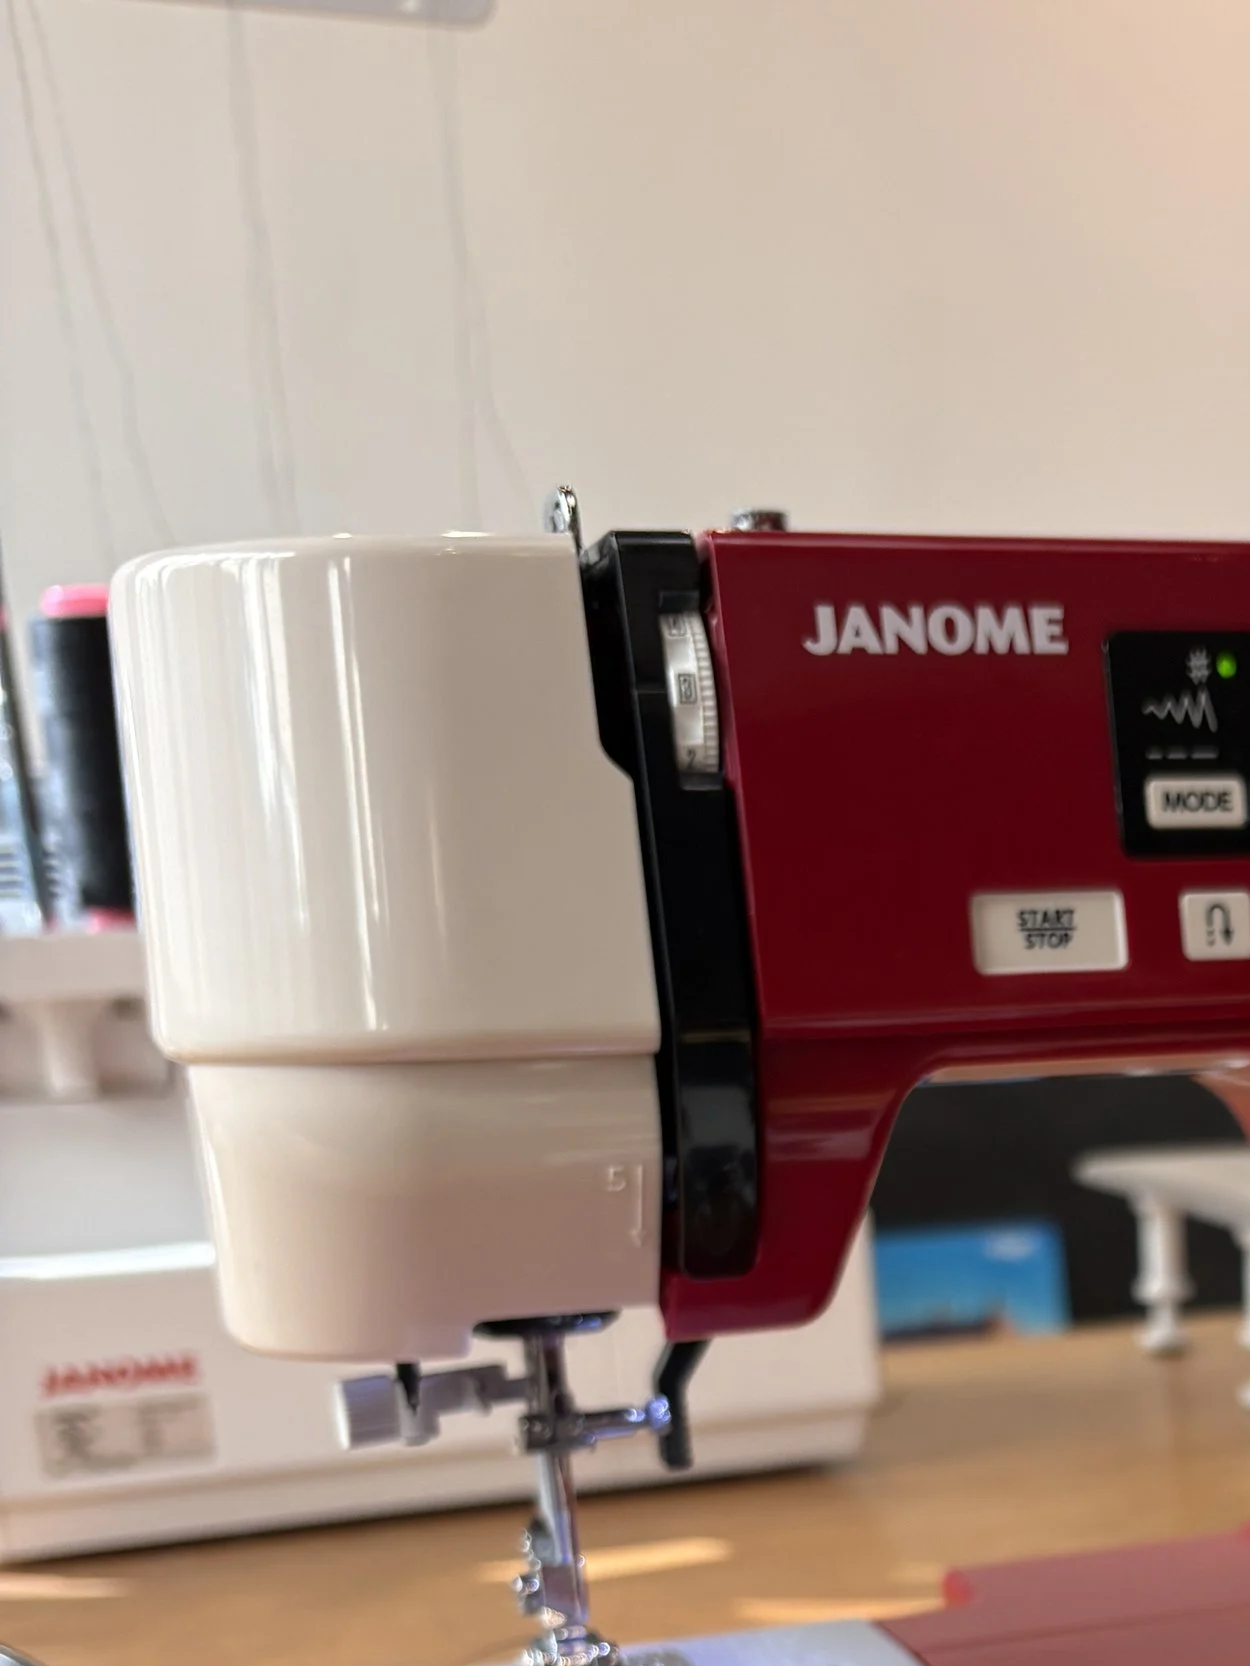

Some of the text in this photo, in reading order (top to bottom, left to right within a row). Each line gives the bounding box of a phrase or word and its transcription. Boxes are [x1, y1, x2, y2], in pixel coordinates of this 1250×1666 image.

[803, 604, 1068, 655] JANOME
[1163, 790, 1234, 813] MODE
[1018, 909, 1075, 928] START
[1025, 932, 1073, 950] STOP
